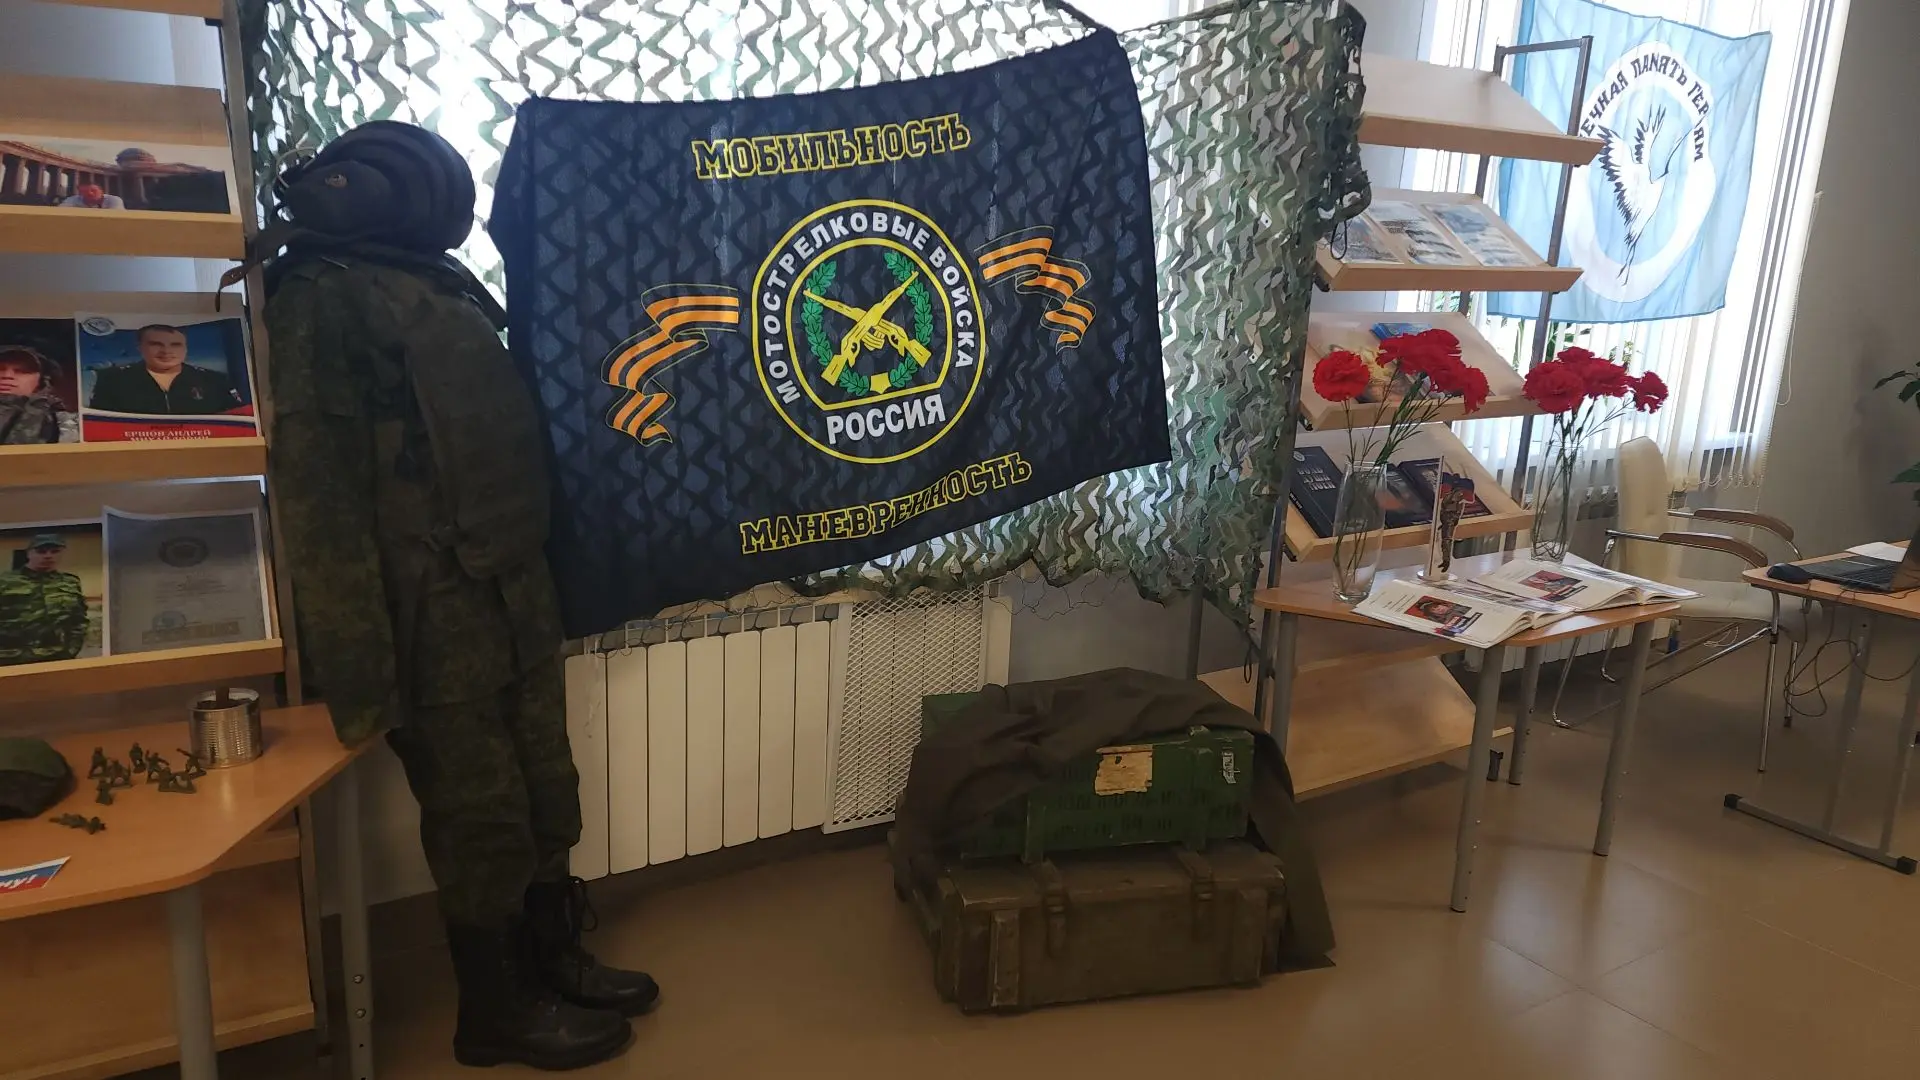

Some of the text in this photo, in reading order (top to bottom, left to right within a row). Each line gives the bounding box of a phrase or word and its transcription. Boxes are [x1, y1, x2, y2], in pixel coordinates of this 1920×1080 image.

[691, 112, 971, 180] МОБИЛЬНОСТЬ
[1579, 70, 1630, 138] ЕЧНАЯ
[1687, 81, 1710, 163] ГЕРЯМ
[763, 211, 976, 405] МОТОСТРЕЛКОВЫЕ ВОЙСКА
[826, 392, 946, 445] РОССИЯ
[740, 452, 1032, 554] МАНЕВРЕННОСТЬ
